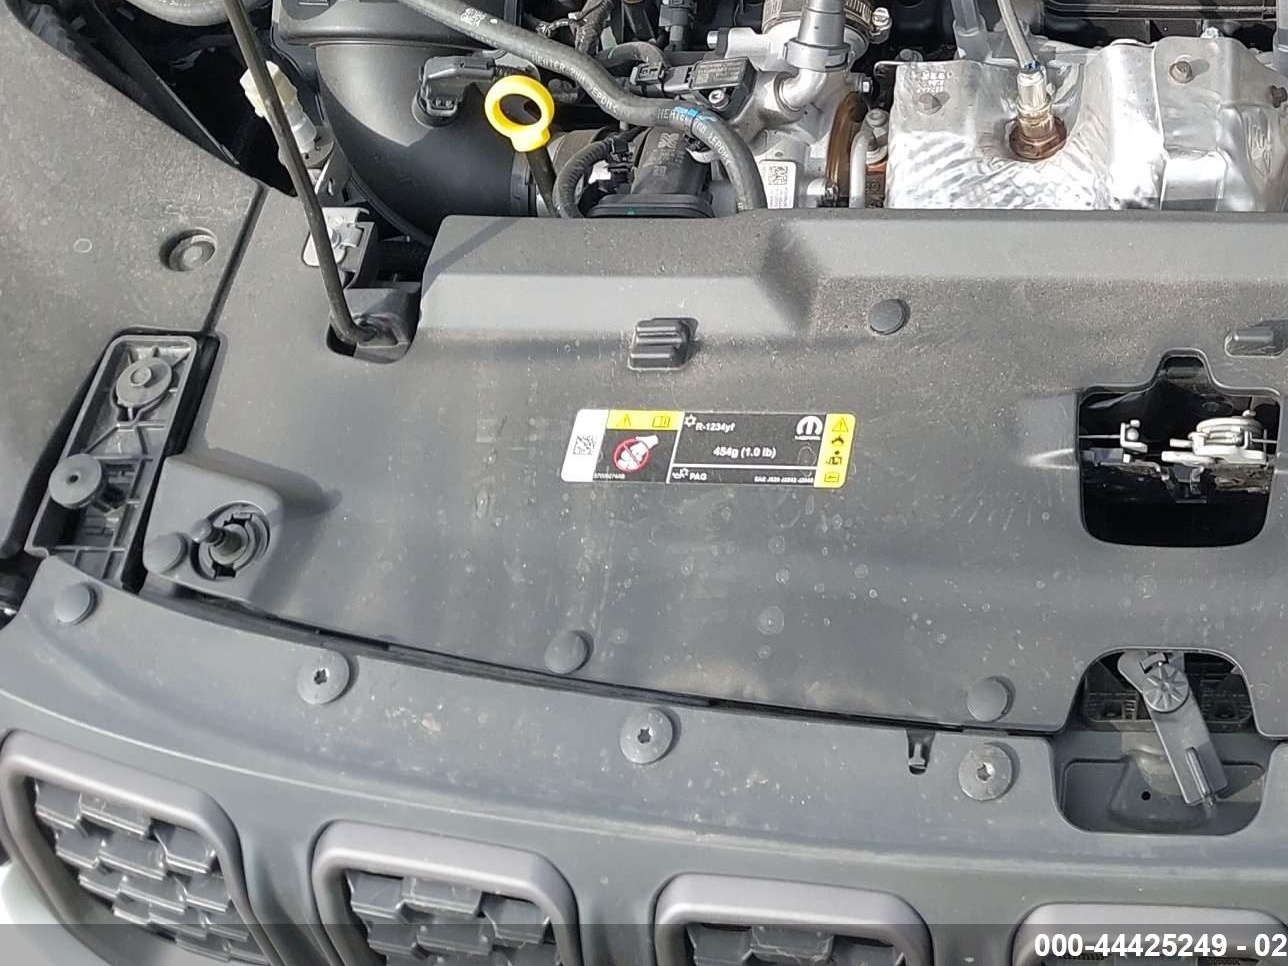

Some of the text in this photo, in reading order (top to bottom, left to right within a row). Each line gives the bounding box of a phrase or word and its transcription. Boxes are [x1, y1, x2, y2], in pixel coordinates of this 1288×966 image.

[695, 422, 736, 433] R-1234yf
[713, 446, 777, 459] 454g (1.0 lb)
[689, 473, 707, 481] PAG
